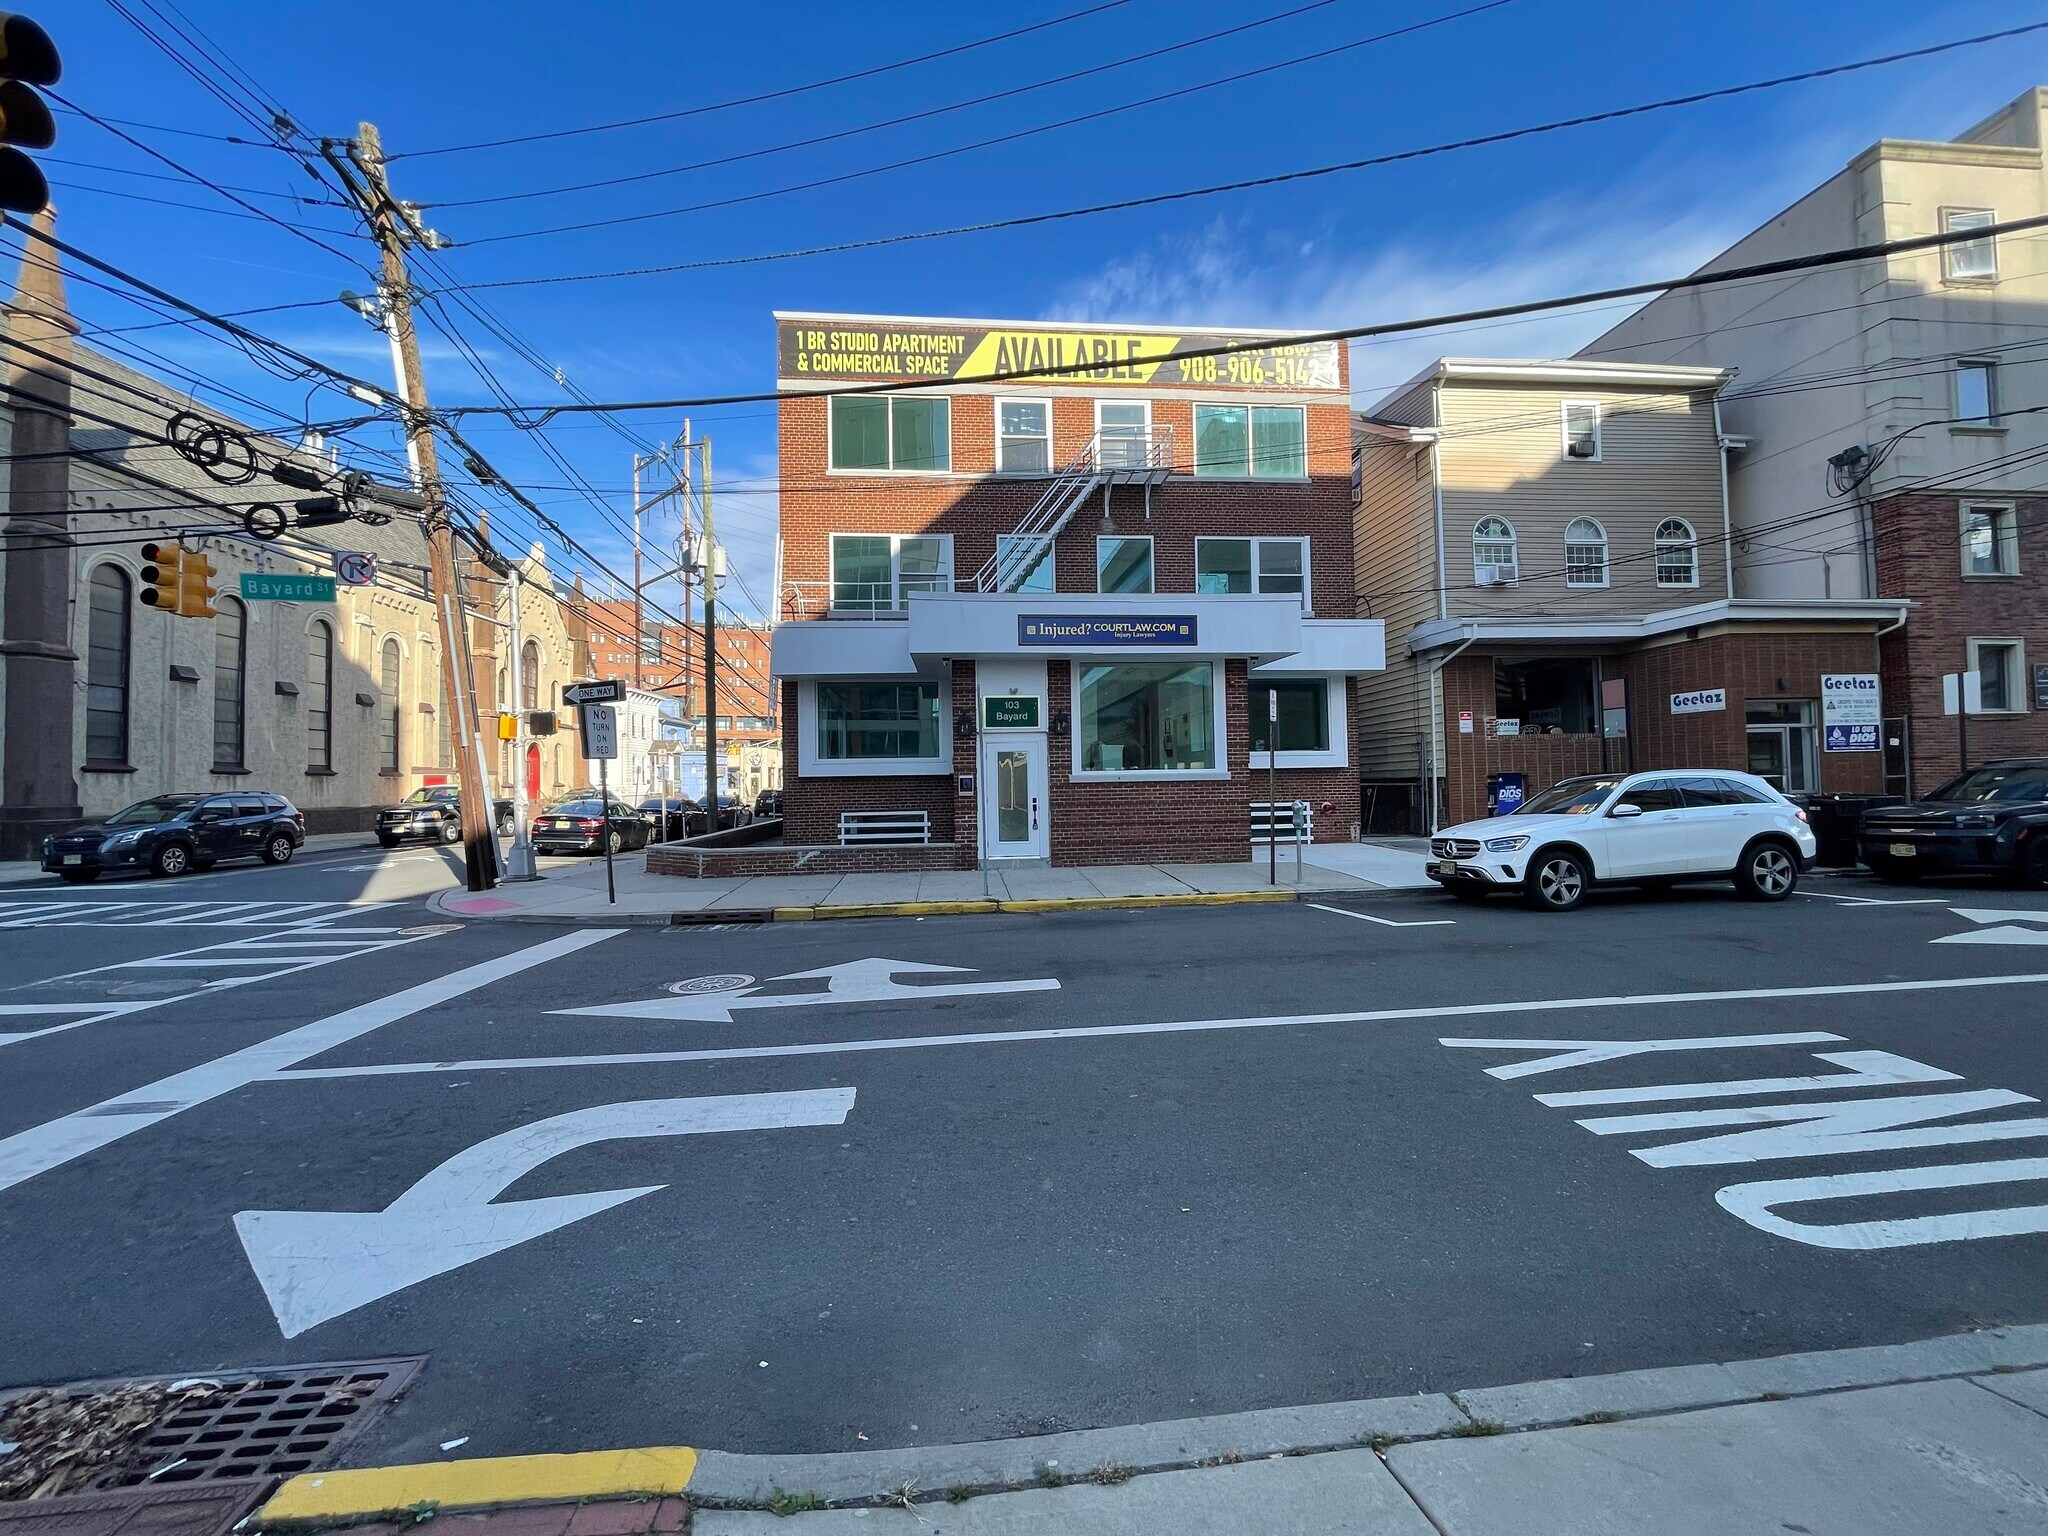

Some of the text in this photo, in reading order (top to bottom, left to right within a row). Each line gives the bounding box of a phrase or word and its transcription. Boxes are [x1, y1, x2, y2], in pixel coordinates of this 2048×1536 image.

[796, 330, 966, 355] 1 BR STUDIO APARTMENT
[994, 336, 1143, 379] AVAILABLE
[797, 352, 949, 375] & COMMERCIAL SPACE
[247, 580, 329, 597] Bayard St
[1039, 622, 1176, 639] Injured? COURTLAW.COM
[1114, 631, 1156, 639] Injury Lawyers
[1824, 676, 1876, 690] Geetaz
[578, 686, 613, 698] ONE WAY
[1004, 701, 1020, 709] 103
[1673, 692, 1723, 707] Geetaz
[593, 709, 607, 720] NO
[996, 712, 1028, 722] Bayard
[592, 722, 610, 732] TURN
[596, 734, 607, 743] ON
[1849, 732, 1877, 743] DIOS
[596, 745, 609, 755] RED
[1498, 788, 1522, 798] DIOS
[1438, 1031, 2048, 1250] ONLY
